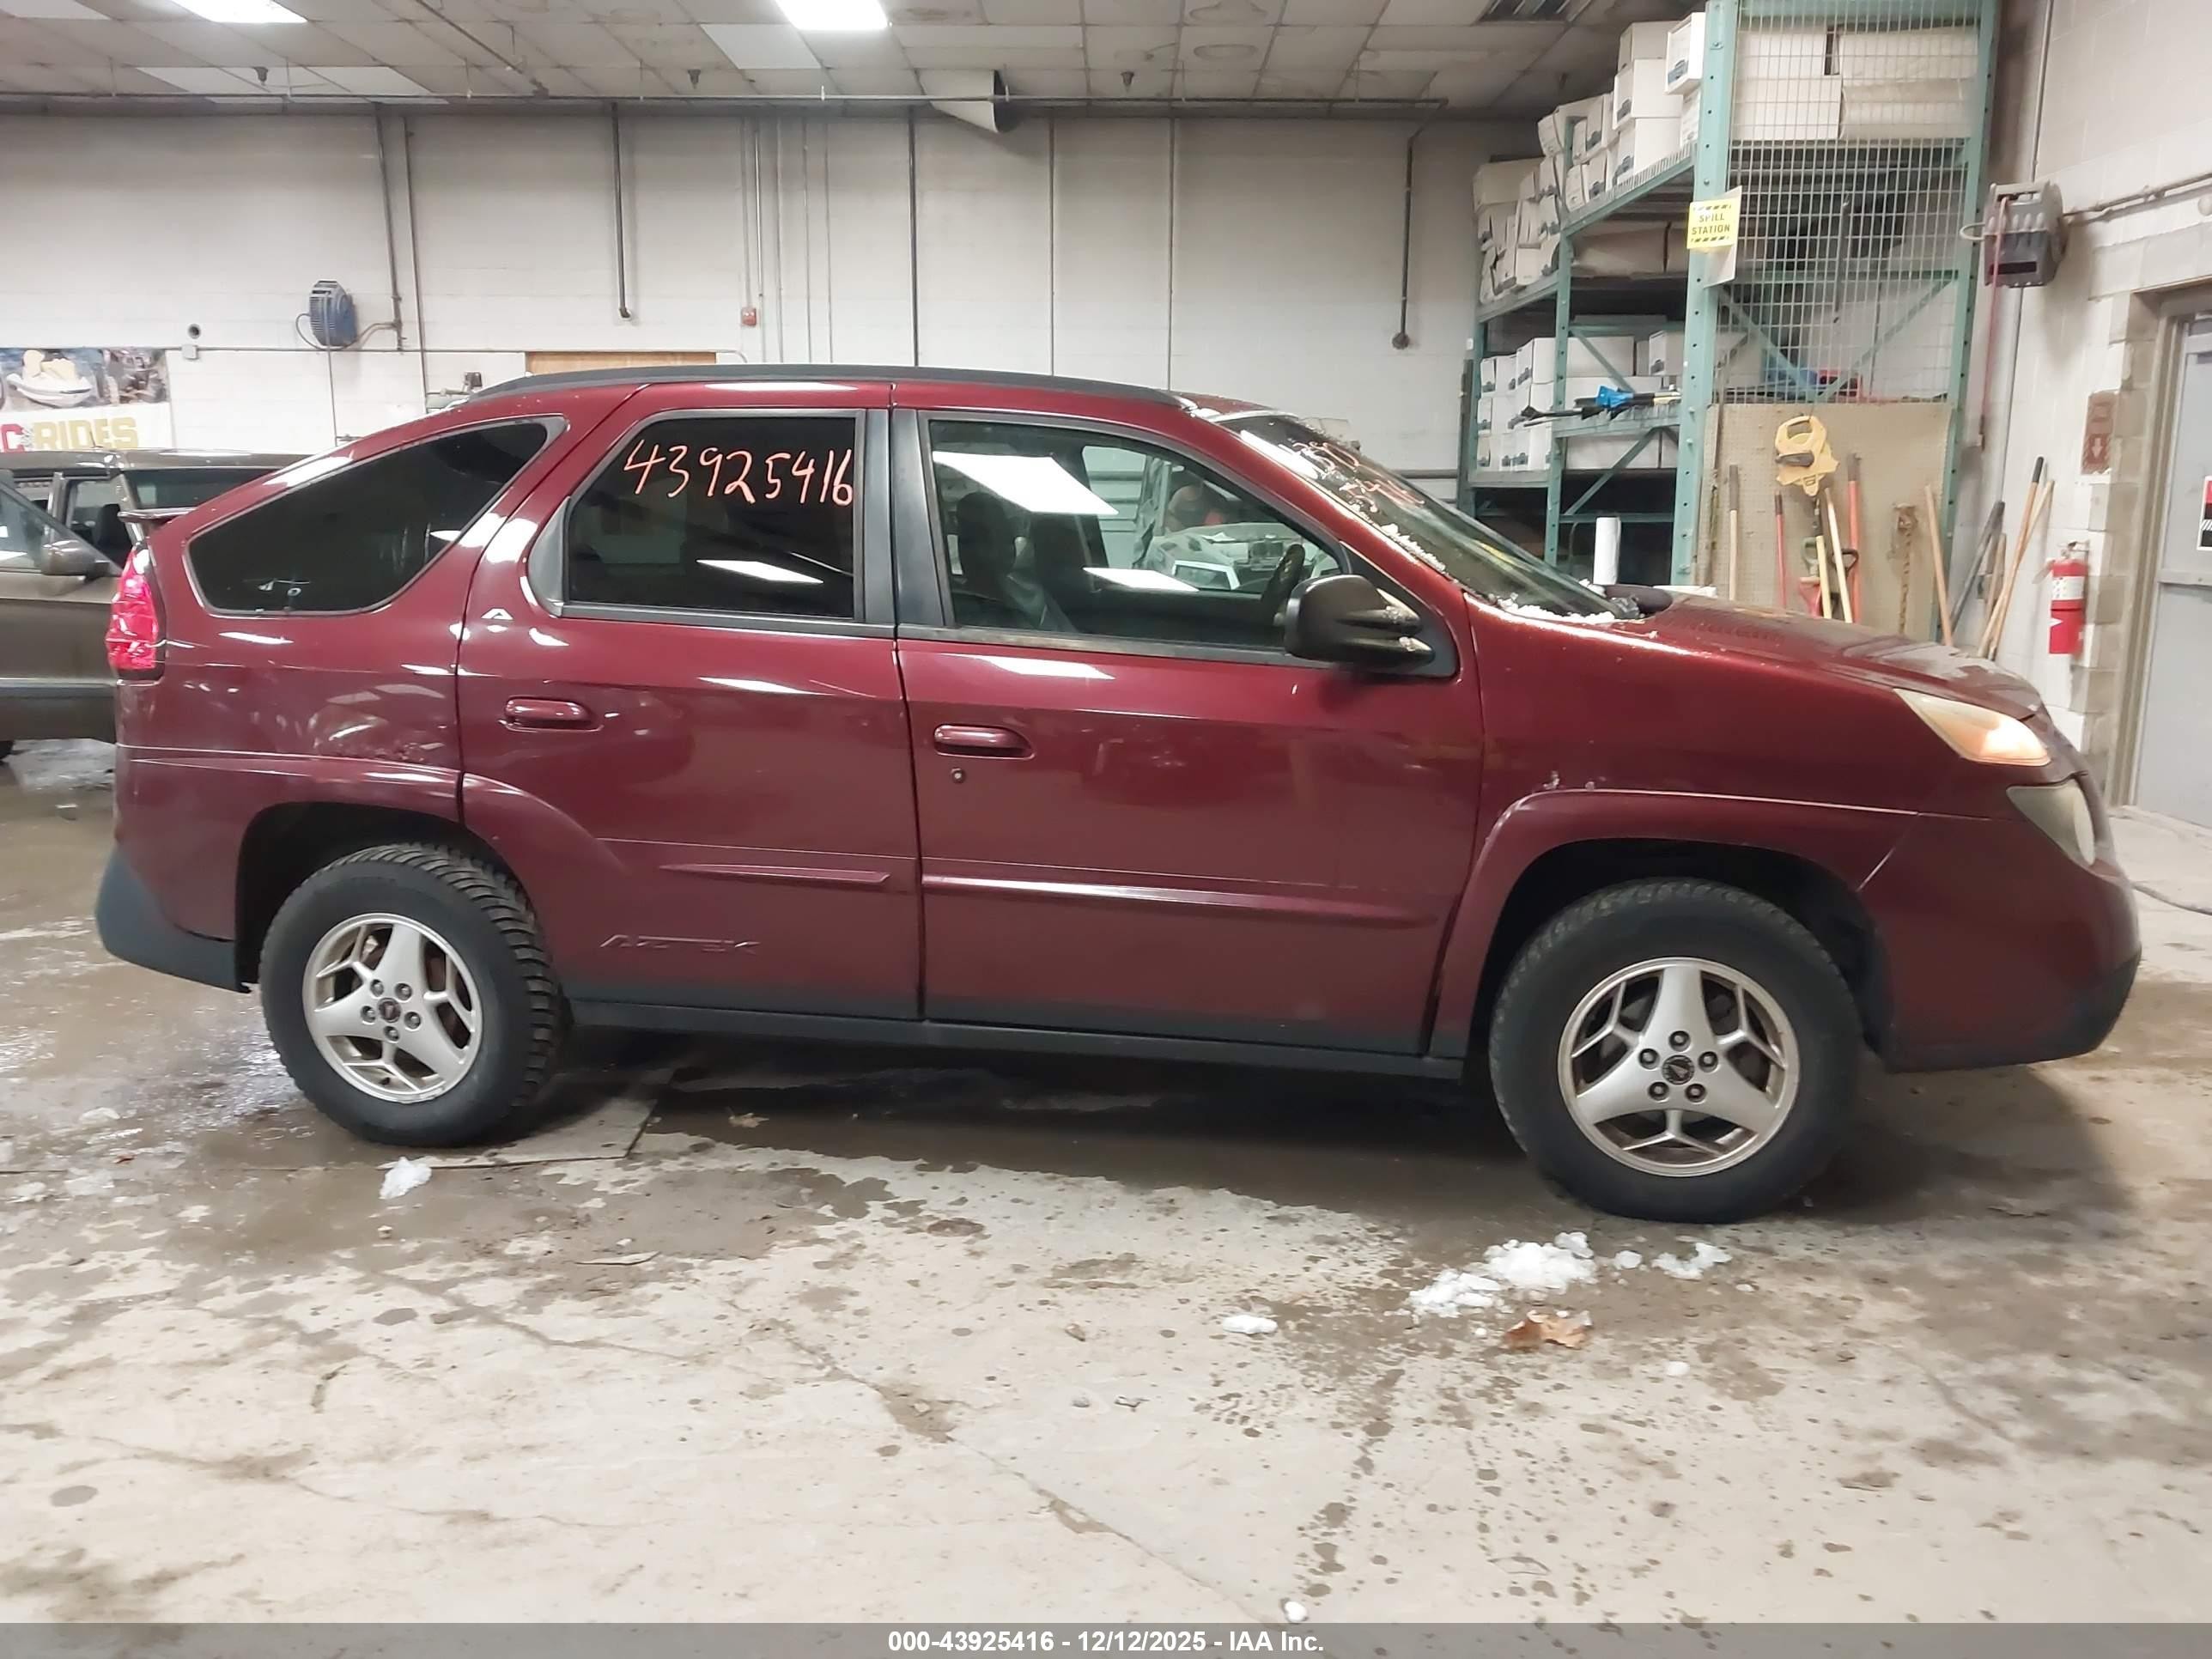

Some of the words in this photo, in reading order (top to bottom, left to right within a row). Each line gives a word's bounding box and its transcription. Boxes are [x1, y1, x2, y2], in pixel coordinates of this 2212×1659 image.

[1698, 212, 1725, 222] SPILL
[1691, 224, 1730, 235] STATION
[33, 416, 138, 452] RIDES
[623, 440, 853, 505] 43925416
